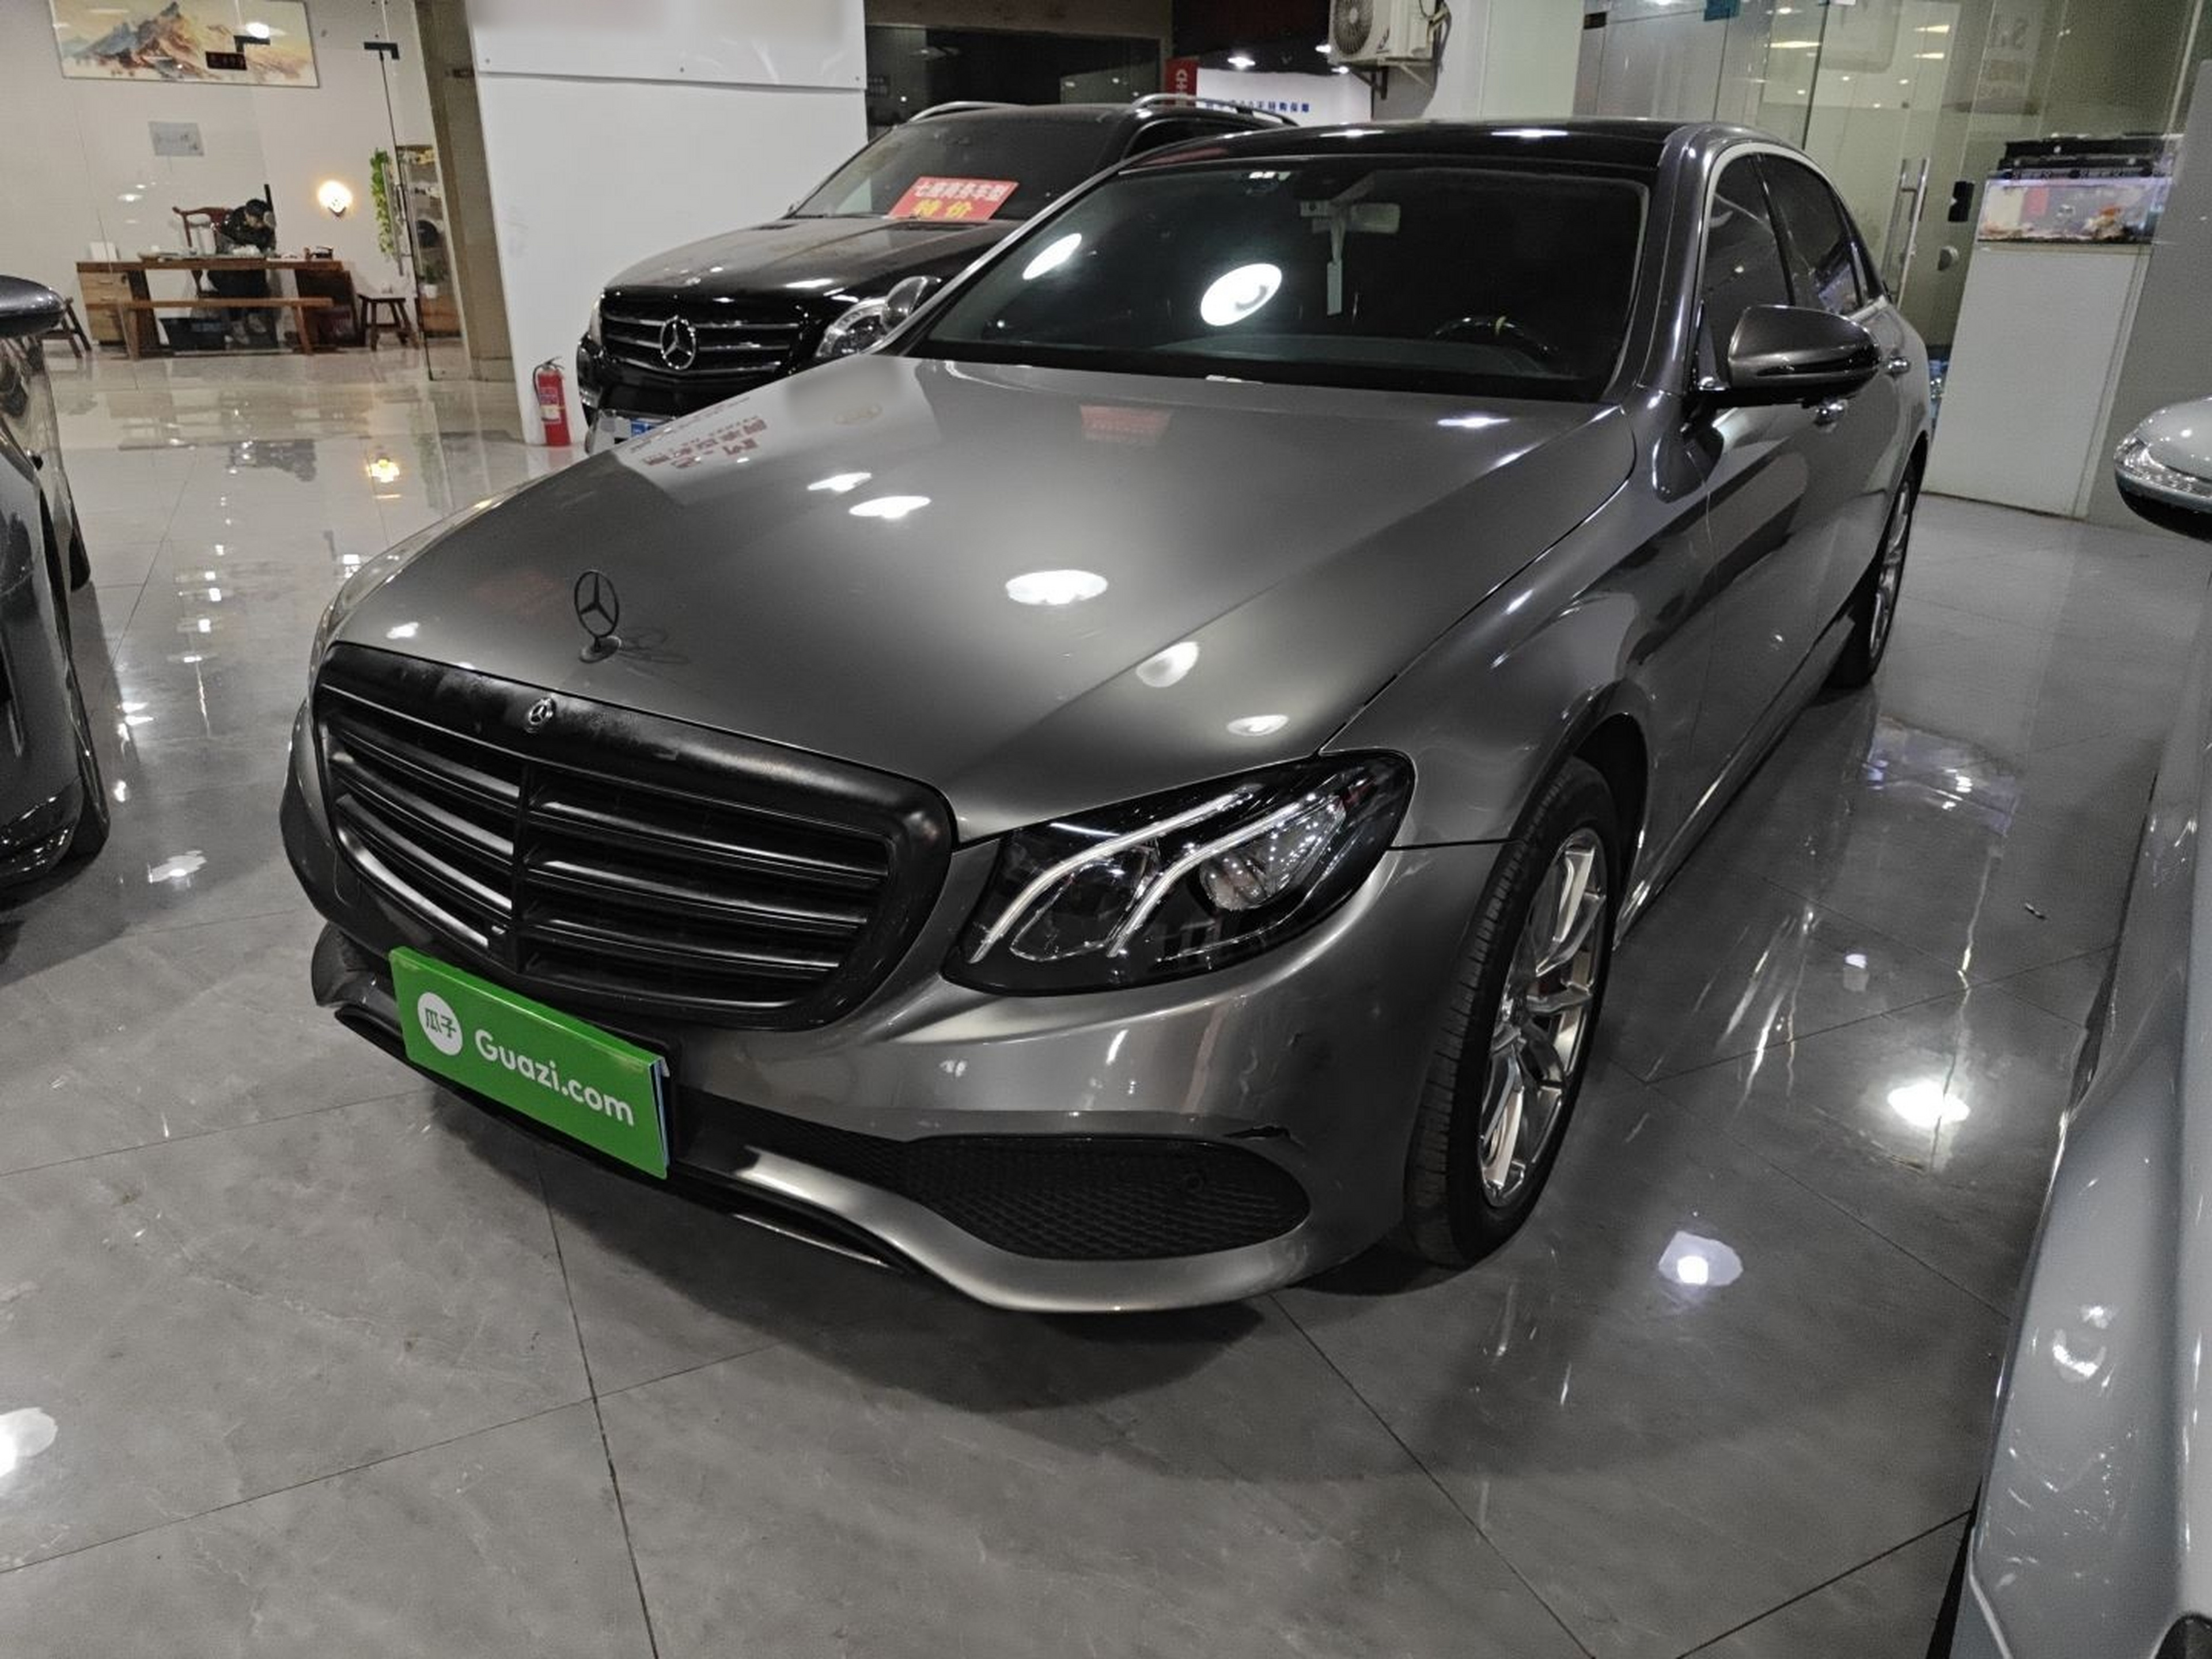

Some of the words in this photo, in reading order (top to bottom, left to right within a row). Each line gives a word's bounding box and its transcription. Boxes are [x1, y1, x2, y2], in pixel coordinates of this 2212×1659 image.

[912, 199, 973, 219] 特价
[424, 1008, 457, 1041] 瓜子
[474, 1029, 635, 1126] Guazi.com
